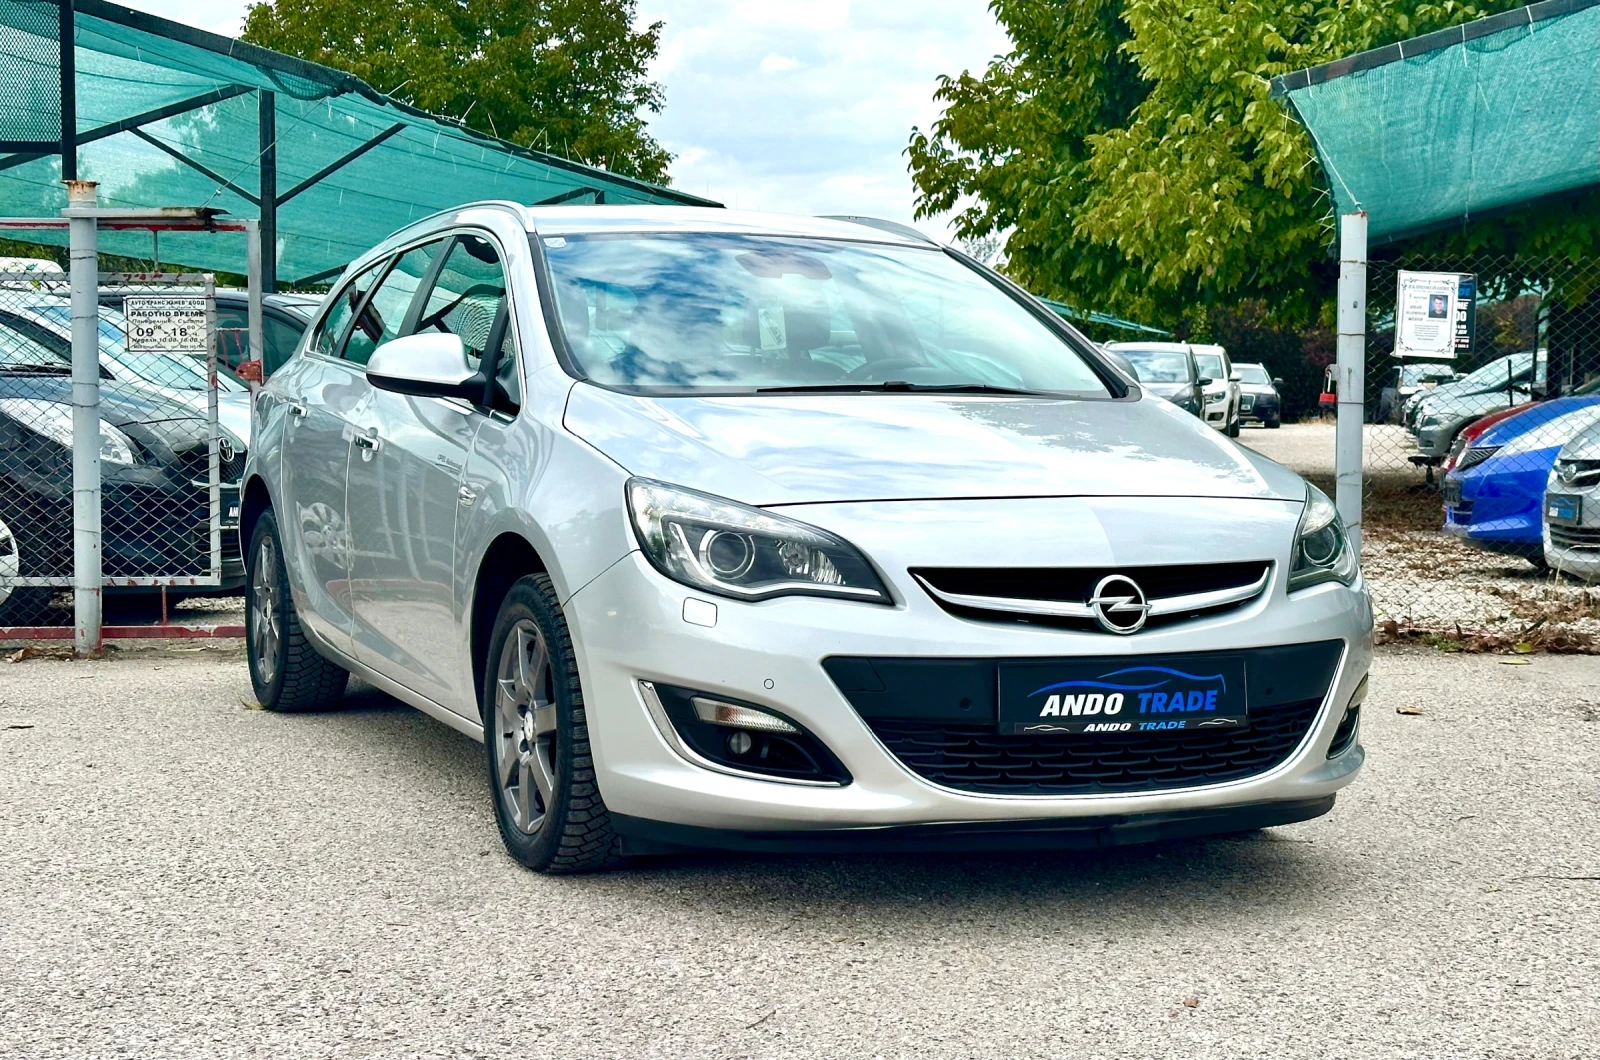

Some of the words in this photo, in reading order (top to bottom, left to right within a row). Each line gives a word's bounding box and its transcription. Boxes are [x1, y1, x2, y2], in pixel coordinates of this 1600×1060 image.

[1039, 692, 1124, 717] ANDO
[1138, 689, 1218, 714] TRADE
[1083, 722, 1132, 732] ANDO
[1138, 720, 1186, 731] TRADE
